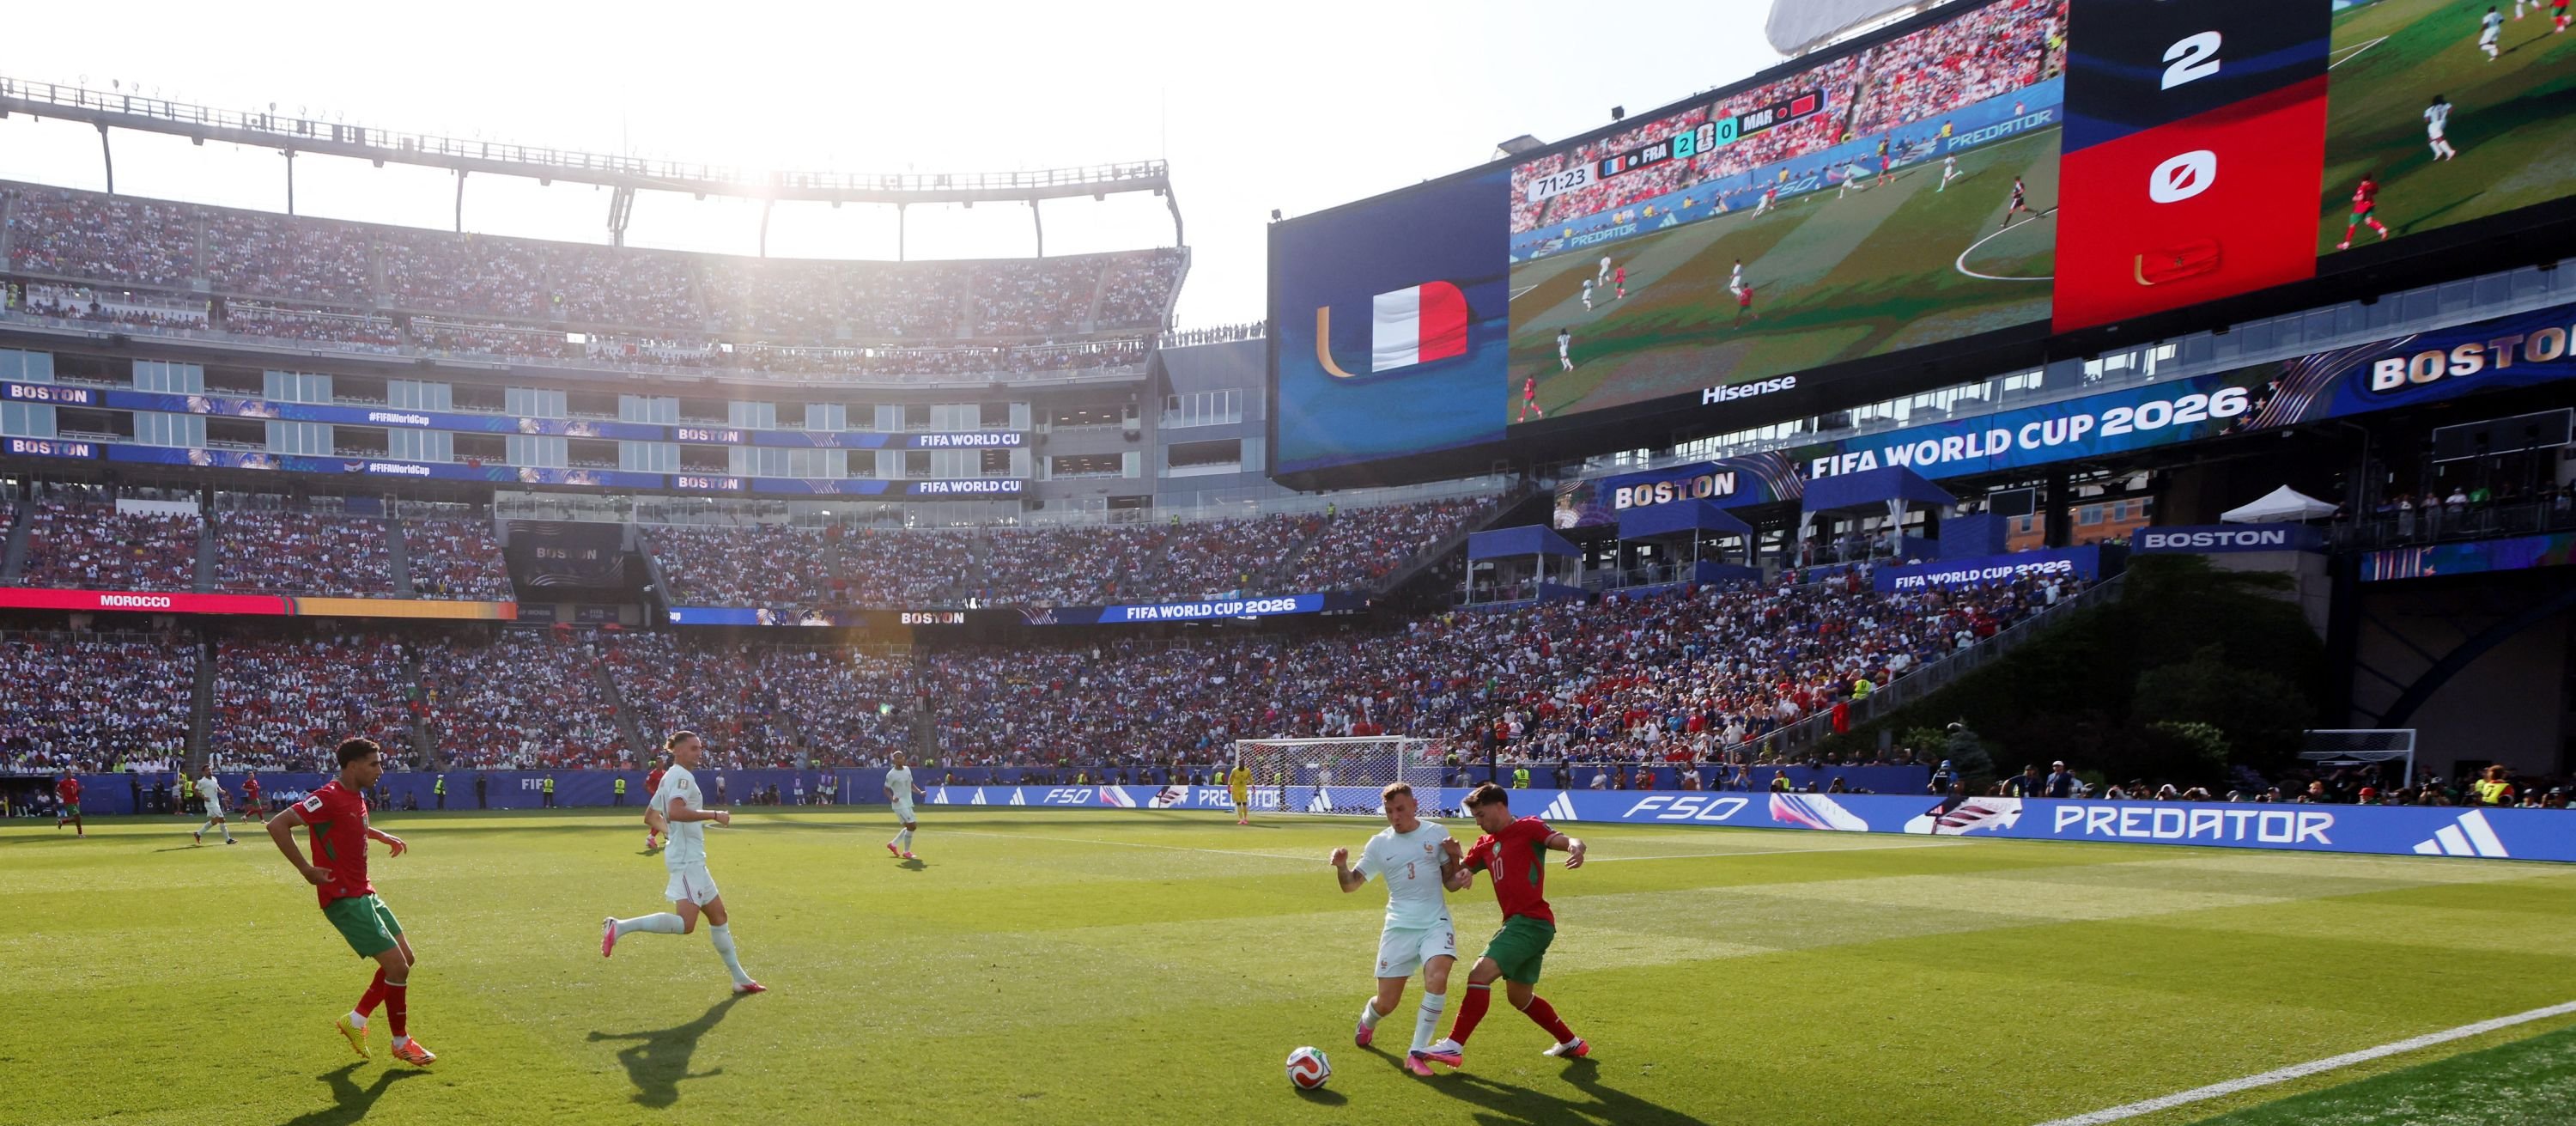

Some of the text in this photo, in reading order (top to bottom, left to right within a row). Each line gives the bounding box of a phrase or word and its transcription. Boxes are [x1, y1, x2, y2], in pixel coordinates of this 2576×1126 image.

[2161, 31, 2222, 91] 2
[1743, 109, 1773, 132] MAR
[1947, 109, 2053, 150] PREDATOR
[1722, 124, 1732, 139] 0
[1642, 143, 1668, 163] FRA
[1679, 137, 1690, 153] 2
[1538, 168, 1586, 197] 71:23
[2149, 149, 2217, 204] 0
[1571, 222, 1637, 247] PREDATOR
[2372, 327, 2576, 391] BOSTO
[11, 385, 88, 403] BOSTON
[1703, 375, 1796, 405] Hisense
[369, 412, 429, 426] #FIFAWorldCup
[678, 429, 738, 442] BOSTON
[920, 435, 950, 446] FIFA
[951, 434, 999, 446] WORLD
[1812, 386, 2248, 480] FIFA WORLD CUP 2026
[13, 440, 88, 457] BOSTON
[370, 463, 430, 477] #FIFAWorldCup
[678, 477, 738, 490] BOSTON
[920, 480, 1022, 493] FIFA WORLD CU
[1615, 472, 1735, 509] BOSTON
[2145, 530, 2285, 548] BOSTON
[1895, 560, 2072, 588] FIFA WORLD CUP 2026
[100, 595, 170, 607] MOROCCO
[1127, 598, 1296, 619] FIFA WORLD CUP 2026
[902, 612, 964, 624] BOSTON
[521, 778, 544, 790] FIF
[1044, 788, 1092, 804] F50
[1622, 795, 1749, 820] F50
[2054, 805, 2335, 844] PREDATOR
[1407, 862, 1415, 879] 3
[1492, 857, 1503, 882] 10
[1446, 932, 1454, 946] 3
